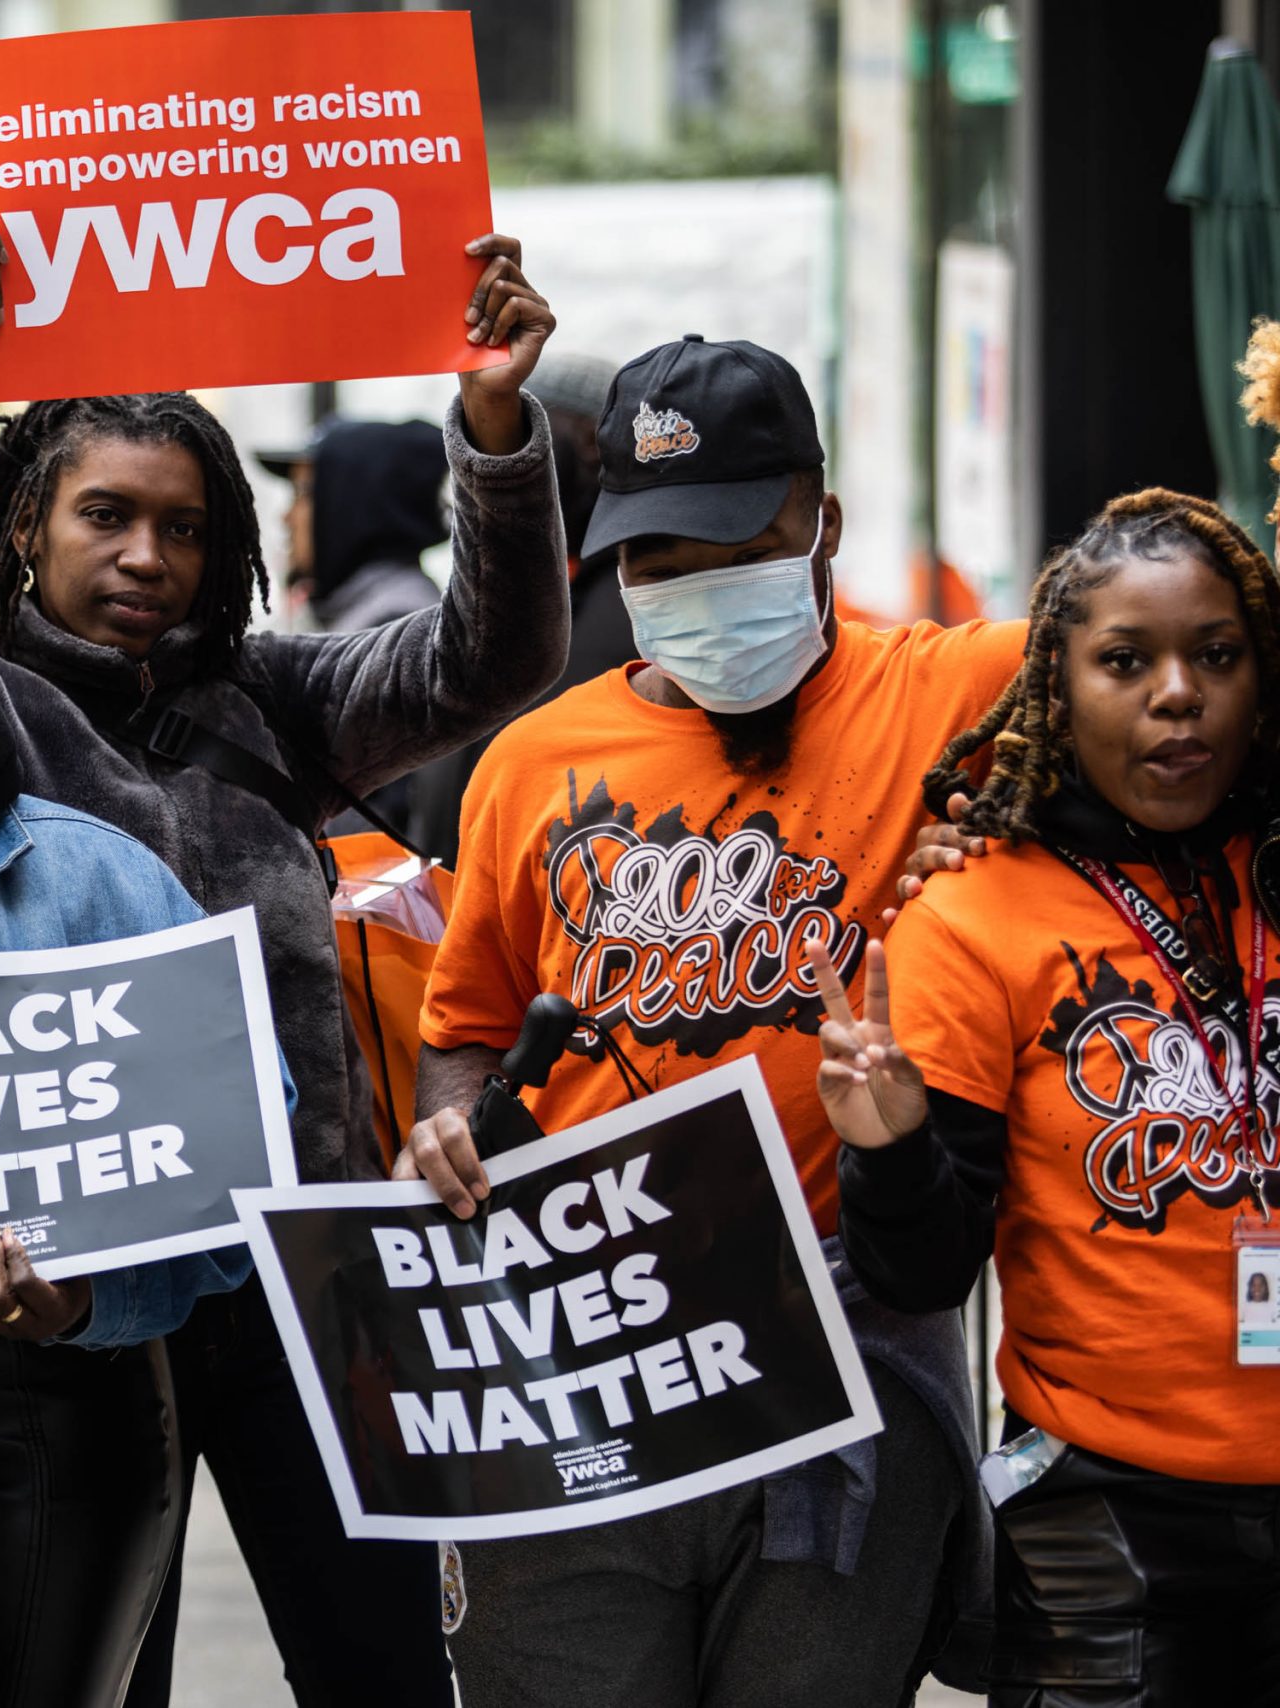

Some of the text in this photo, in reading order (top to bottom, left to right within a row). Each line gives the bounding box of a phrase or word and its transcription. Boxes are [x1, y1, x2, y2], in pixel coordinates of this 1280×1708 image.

[274, 84, 421, 122] racism
[304, 135, 461, 169] women
[0, 187, 406, 328] ywca
[606, 829, 838, 940] 202 for
[571, 906, 860, 1046] Peace
[371, 1153, 672, 1288] BLACK
[418, 1253, 670, 1370] LIVES
[390, 1321, 763, 1455] MATTER
[553, 1438, 623, 1459] eliminating racism
[555, 1443, 632, 1466] empowering women
[557, 1455, 626, 1487] ywca
[564, 1474, 639, 1496] National Capital Area
